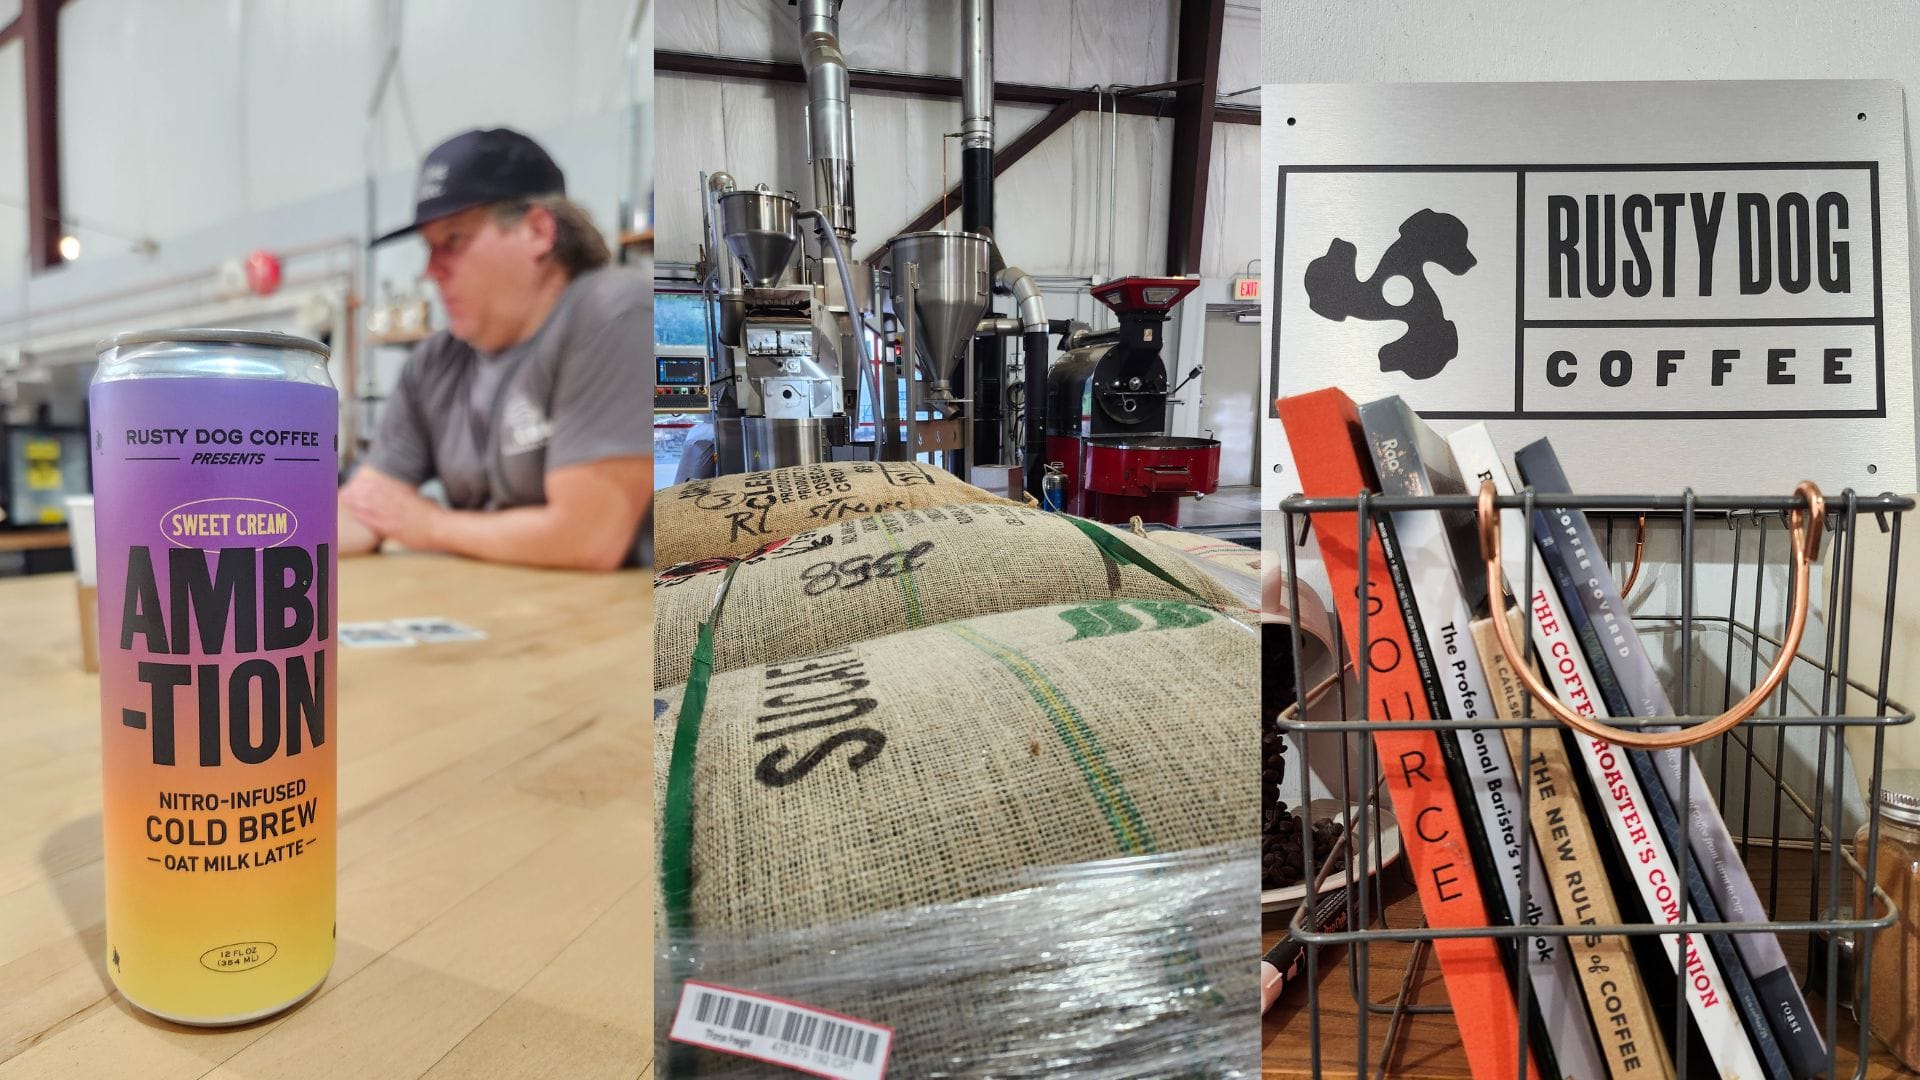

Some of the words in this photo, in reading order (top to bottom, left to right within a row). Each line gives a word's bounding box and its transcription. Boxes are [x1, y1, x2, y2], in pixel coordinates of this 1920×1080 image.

[1547, 191, 1725, 298] RUSTY
[1737, 191, 1851, 295] DOG
[1240, 281, 1258, 297] EXIT
[1546, 348, 1852, 387] COFFEE
[126, 429, 188, 445] RUSTY
[195, 429, 243, 444] DOG
[249, 429, 319, 446] COFFEE
[1382, 439, 1400, 471] Rao
[191, 453, 265, 465] PRESENTS
[172, 513, 231, 536] SWEET
[237, 512, 287, 536] CREAM
[120, 543, 329, 655] AMBI
[1588, 577, 1630, 658] COVERED
[122, 650, 325, 767] -TION
[1532, 590, 1561, 637] THE
[1592, 737, 1656, 866] ROASTER'S
[1354, 582, 1463, 903] SOURCE
[1441, 622, 1458, 655] The
[1452, 660, 1499, 775] Profesonal
[1488, 778, 1520, 859] Barista's
[160, 779, 306, 811] NITRO-INFUSED
[146, 815, 228, 847] COLD
[238, 797, 317, 844] BREW
[204, 852, 250, 872] MILK
[253, 838, 304, 867] LATTE
[1529, 752, 1556, 801] THE
[1546, 806, 1577, 863] NEW
[1588, 954, 1610, 975] of
[1600, 980, 1642, 1073] COFFEE
[246, 947, 257, 955] OZ
[1780, 1001, 1802, 1034] roast
